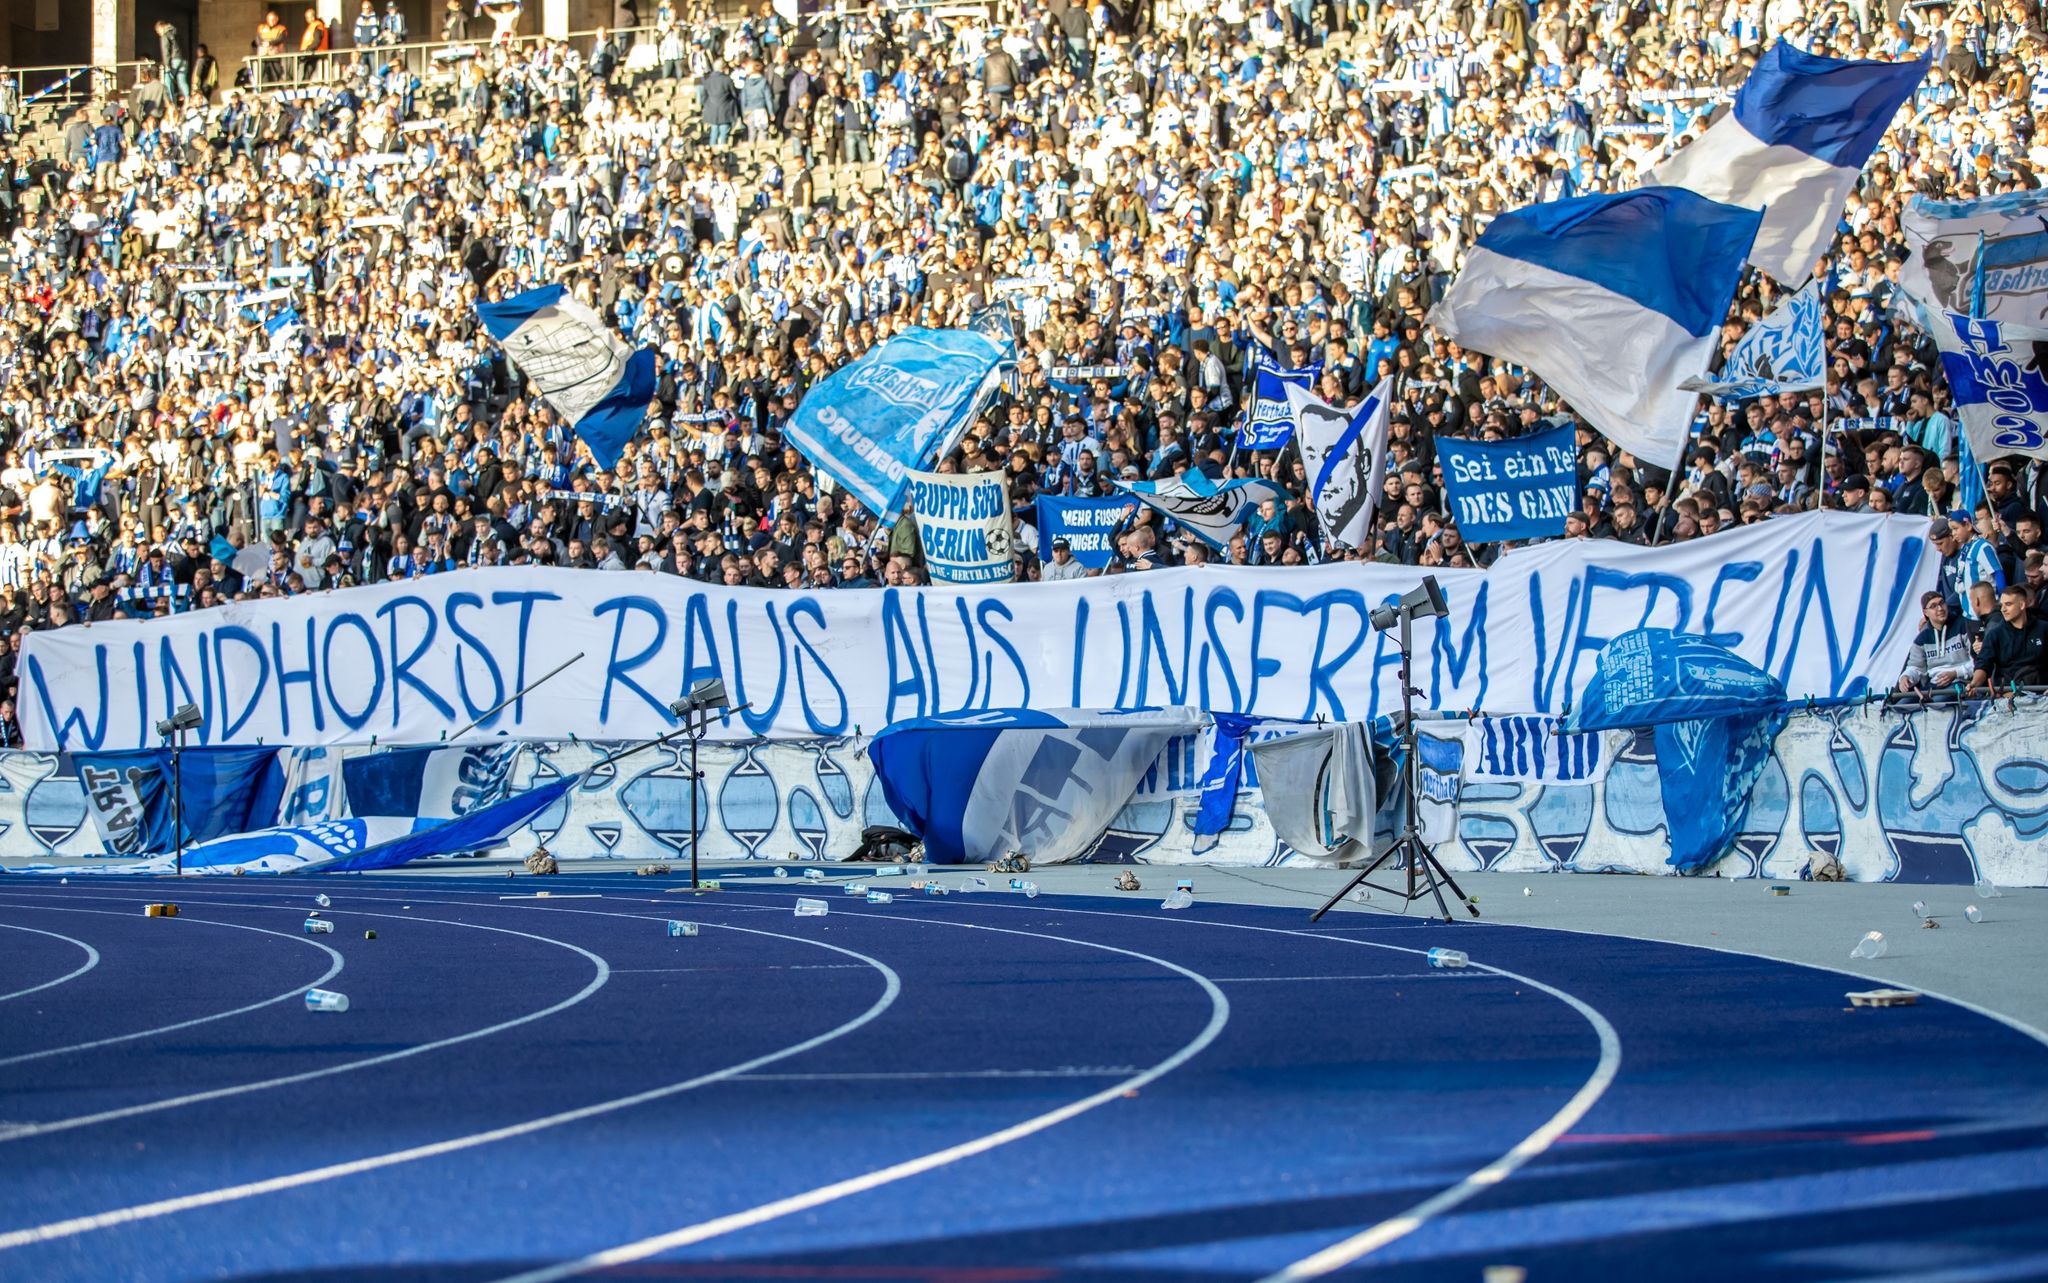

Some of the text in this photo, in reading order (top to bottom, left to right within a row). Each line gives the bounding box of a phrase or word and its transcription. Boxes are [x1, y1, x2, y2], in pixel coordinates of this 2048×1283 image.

[1449, 445, 1575, 483] Sei ein Tei
[1061, 507, 1125, 527] MEHR FUSSB
[1458, 491, 1514, 525] DES
[922, 523, 988, 562] BERLIN
[28, 532, 1924, 750] WINDHORST RAUS AUS UNSEREM VEREIN!
